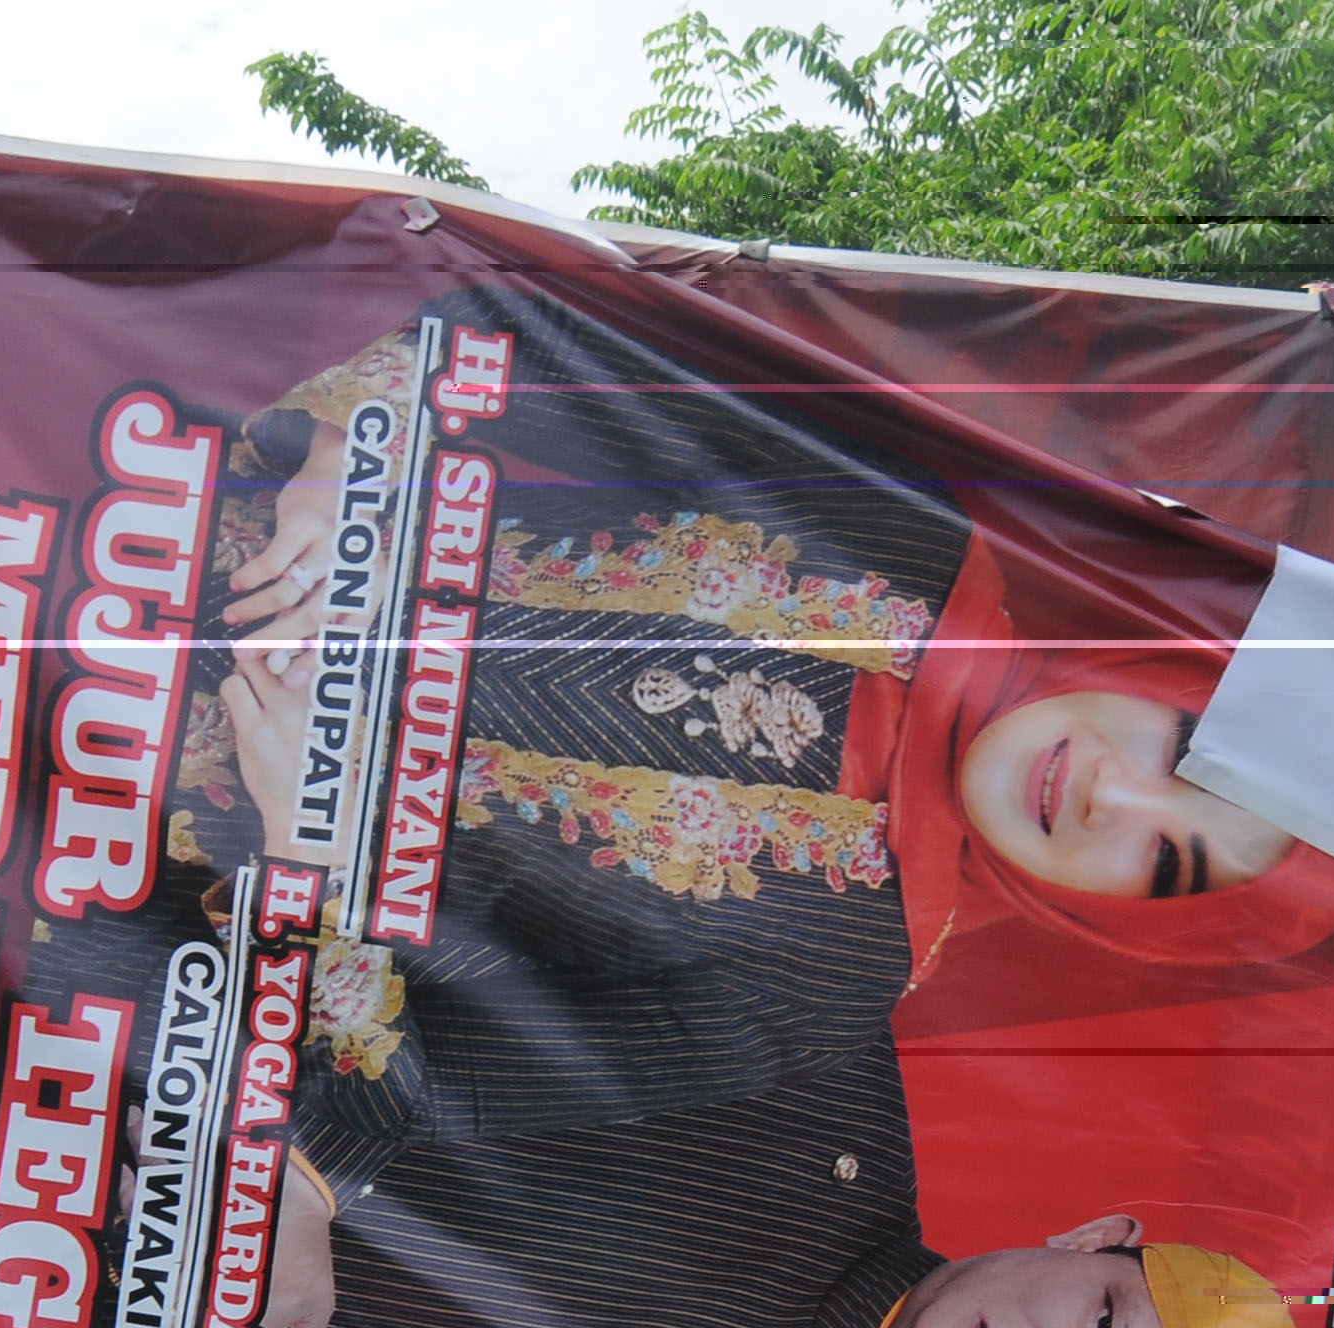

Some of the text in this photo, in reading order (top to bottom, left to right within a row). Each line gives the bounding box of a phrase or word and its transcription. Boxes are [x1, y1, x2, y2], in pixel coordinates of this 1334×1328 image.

[42, 398, 213, 907] JUJUR
[296, 405, 389, 842] CALON BUPATI
[376, 331, 509, 941] Hj. SRI MULYANI
[150, 951, 217, 1153] CALON
[235, 954, 302, 1127] YOGA
[262, 870, 315, 935] H.
